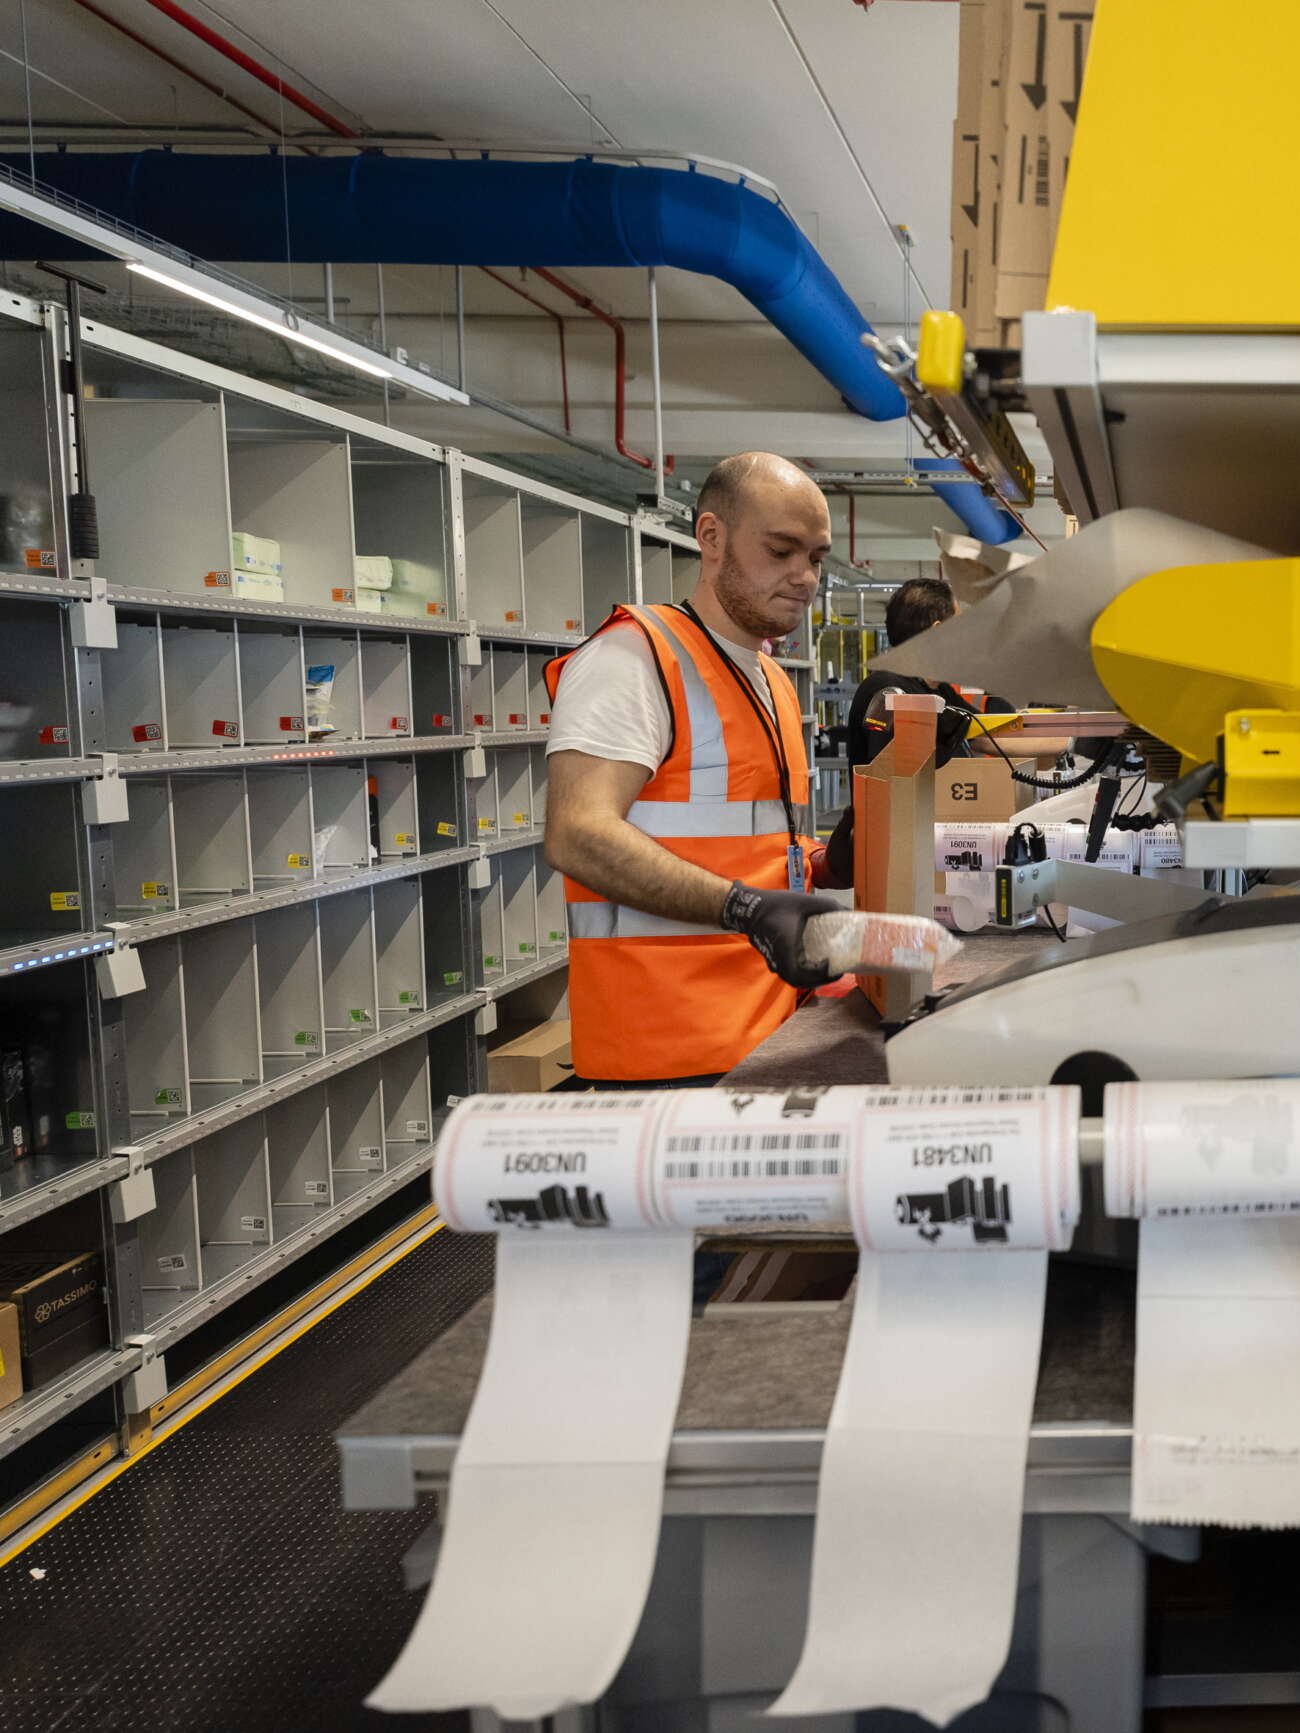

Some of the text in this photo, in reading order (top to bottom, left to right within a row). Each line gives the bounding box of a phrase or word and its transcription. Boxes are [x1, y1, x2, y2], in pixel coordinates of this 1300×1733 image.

[950, 783, 978, 800] E3
[504, 1151, 587, 1175] UN3091
[912, 1143, 992, 1167] UN3481
[51, 1281, 97, 1312] TASSIMO
